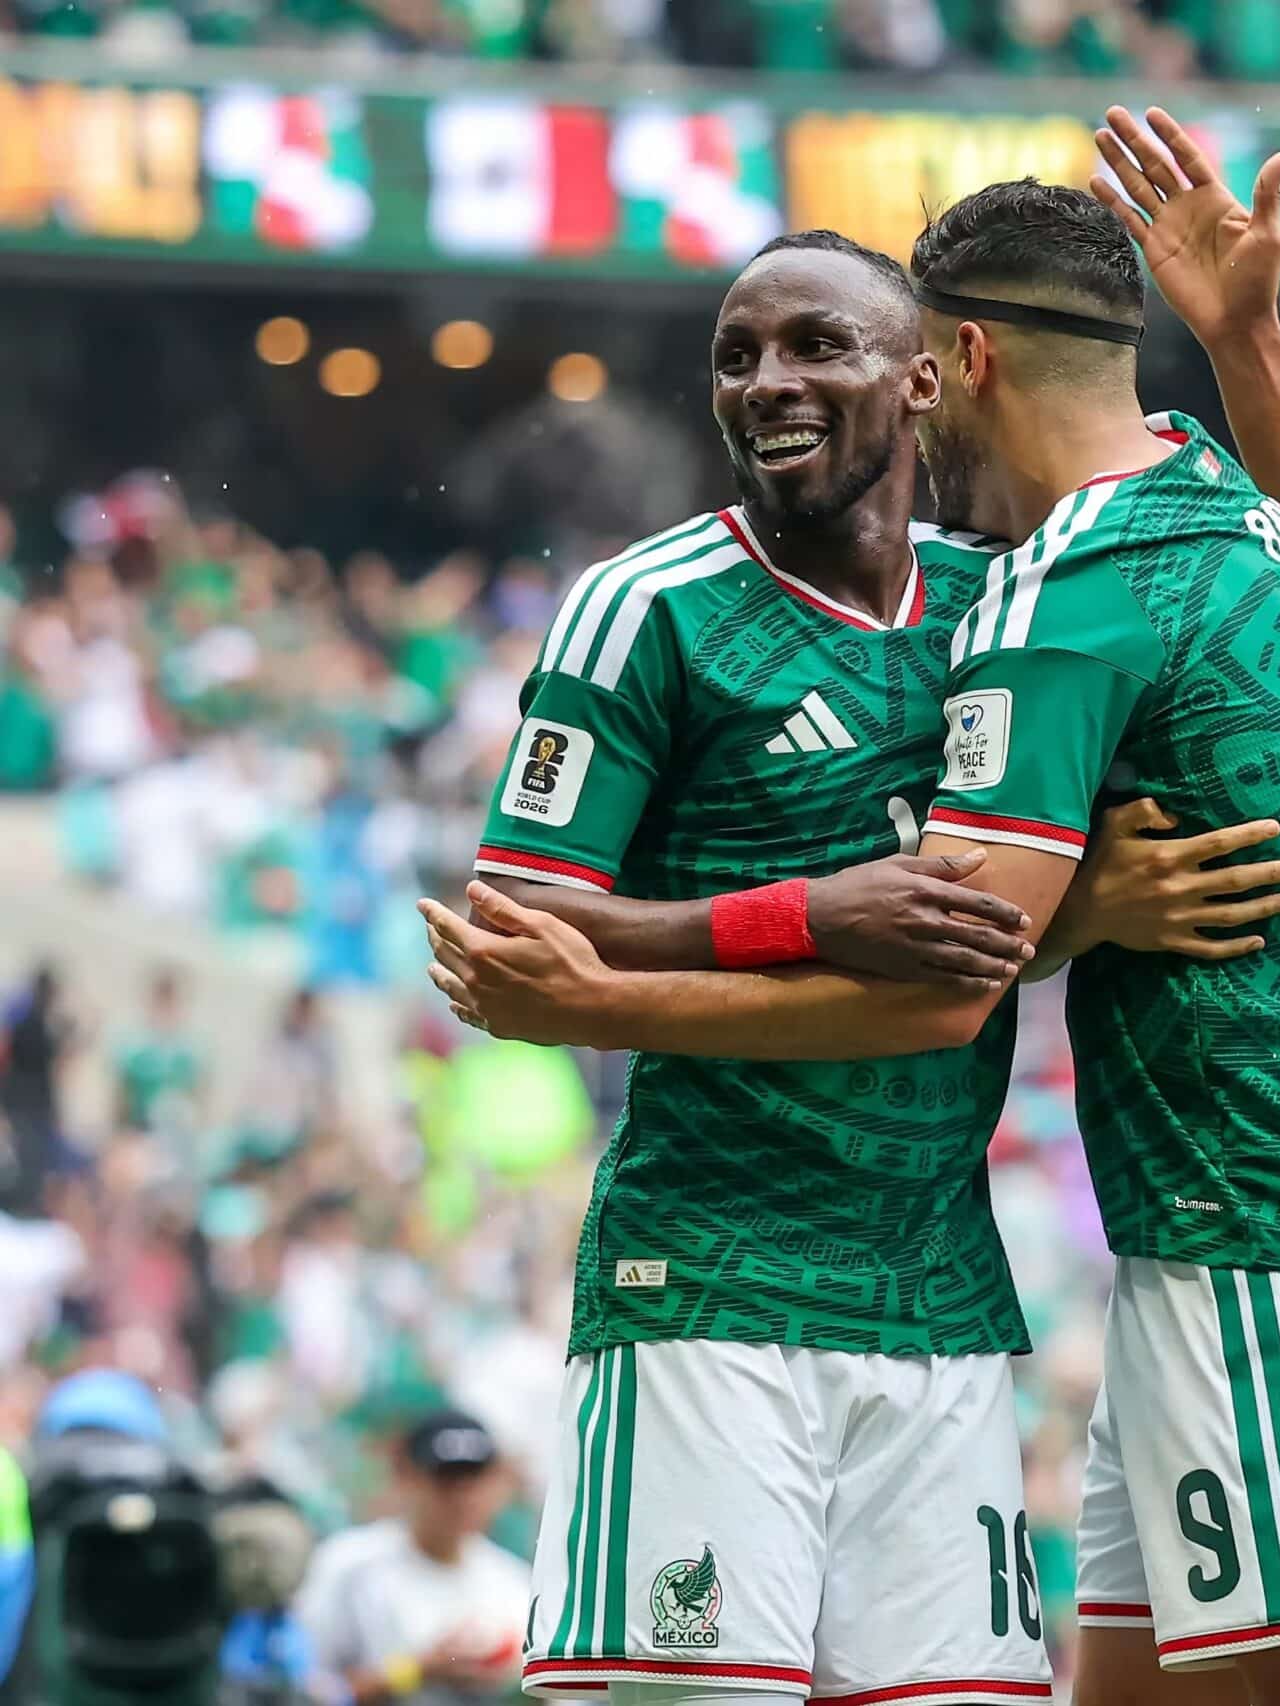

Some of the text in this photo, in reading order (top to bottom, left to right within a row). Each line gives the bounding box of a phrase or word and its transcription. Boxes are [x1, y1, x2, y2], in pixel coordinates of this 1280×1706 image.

[958, 750, 986, 770] PEACE
[514, 798, 549, 814] 2026
[1175, 1468, 1241, 1602] 9
[655, 1627, 716, 1645] MÉXICO
